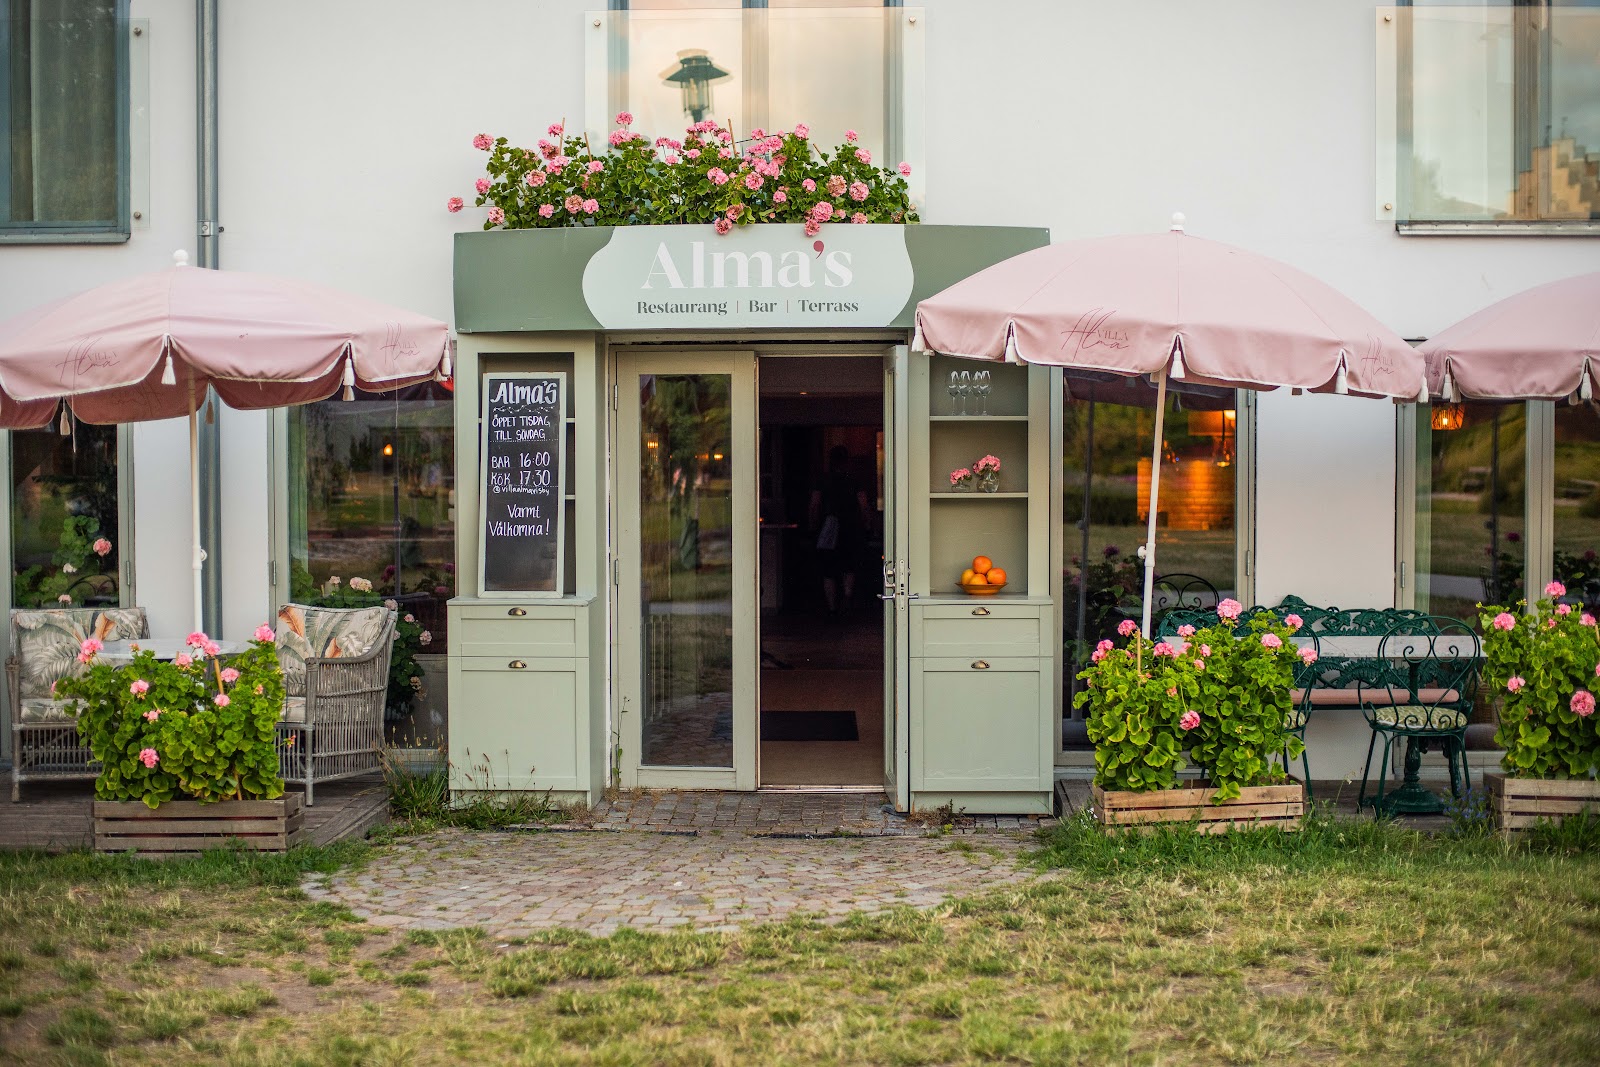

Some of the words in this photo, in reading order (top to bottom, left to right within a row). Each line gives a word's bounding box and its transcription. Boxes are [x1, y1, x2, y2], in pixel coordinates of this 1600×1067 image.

[640, 240, 853, 289] Alma's
[637, 301, 728, 315] Restaurang
[749, 300, 778, 313] Bar
[798, 299, 859, 313] Terrass
[519, 415, 551, 427] TISDAG
[494, 430, 512, 441] TILL
[491, 456, 510, 469] BAR
[520, 451, 550, 468] 16:00
[507, 504, 540, 519] Varmt
